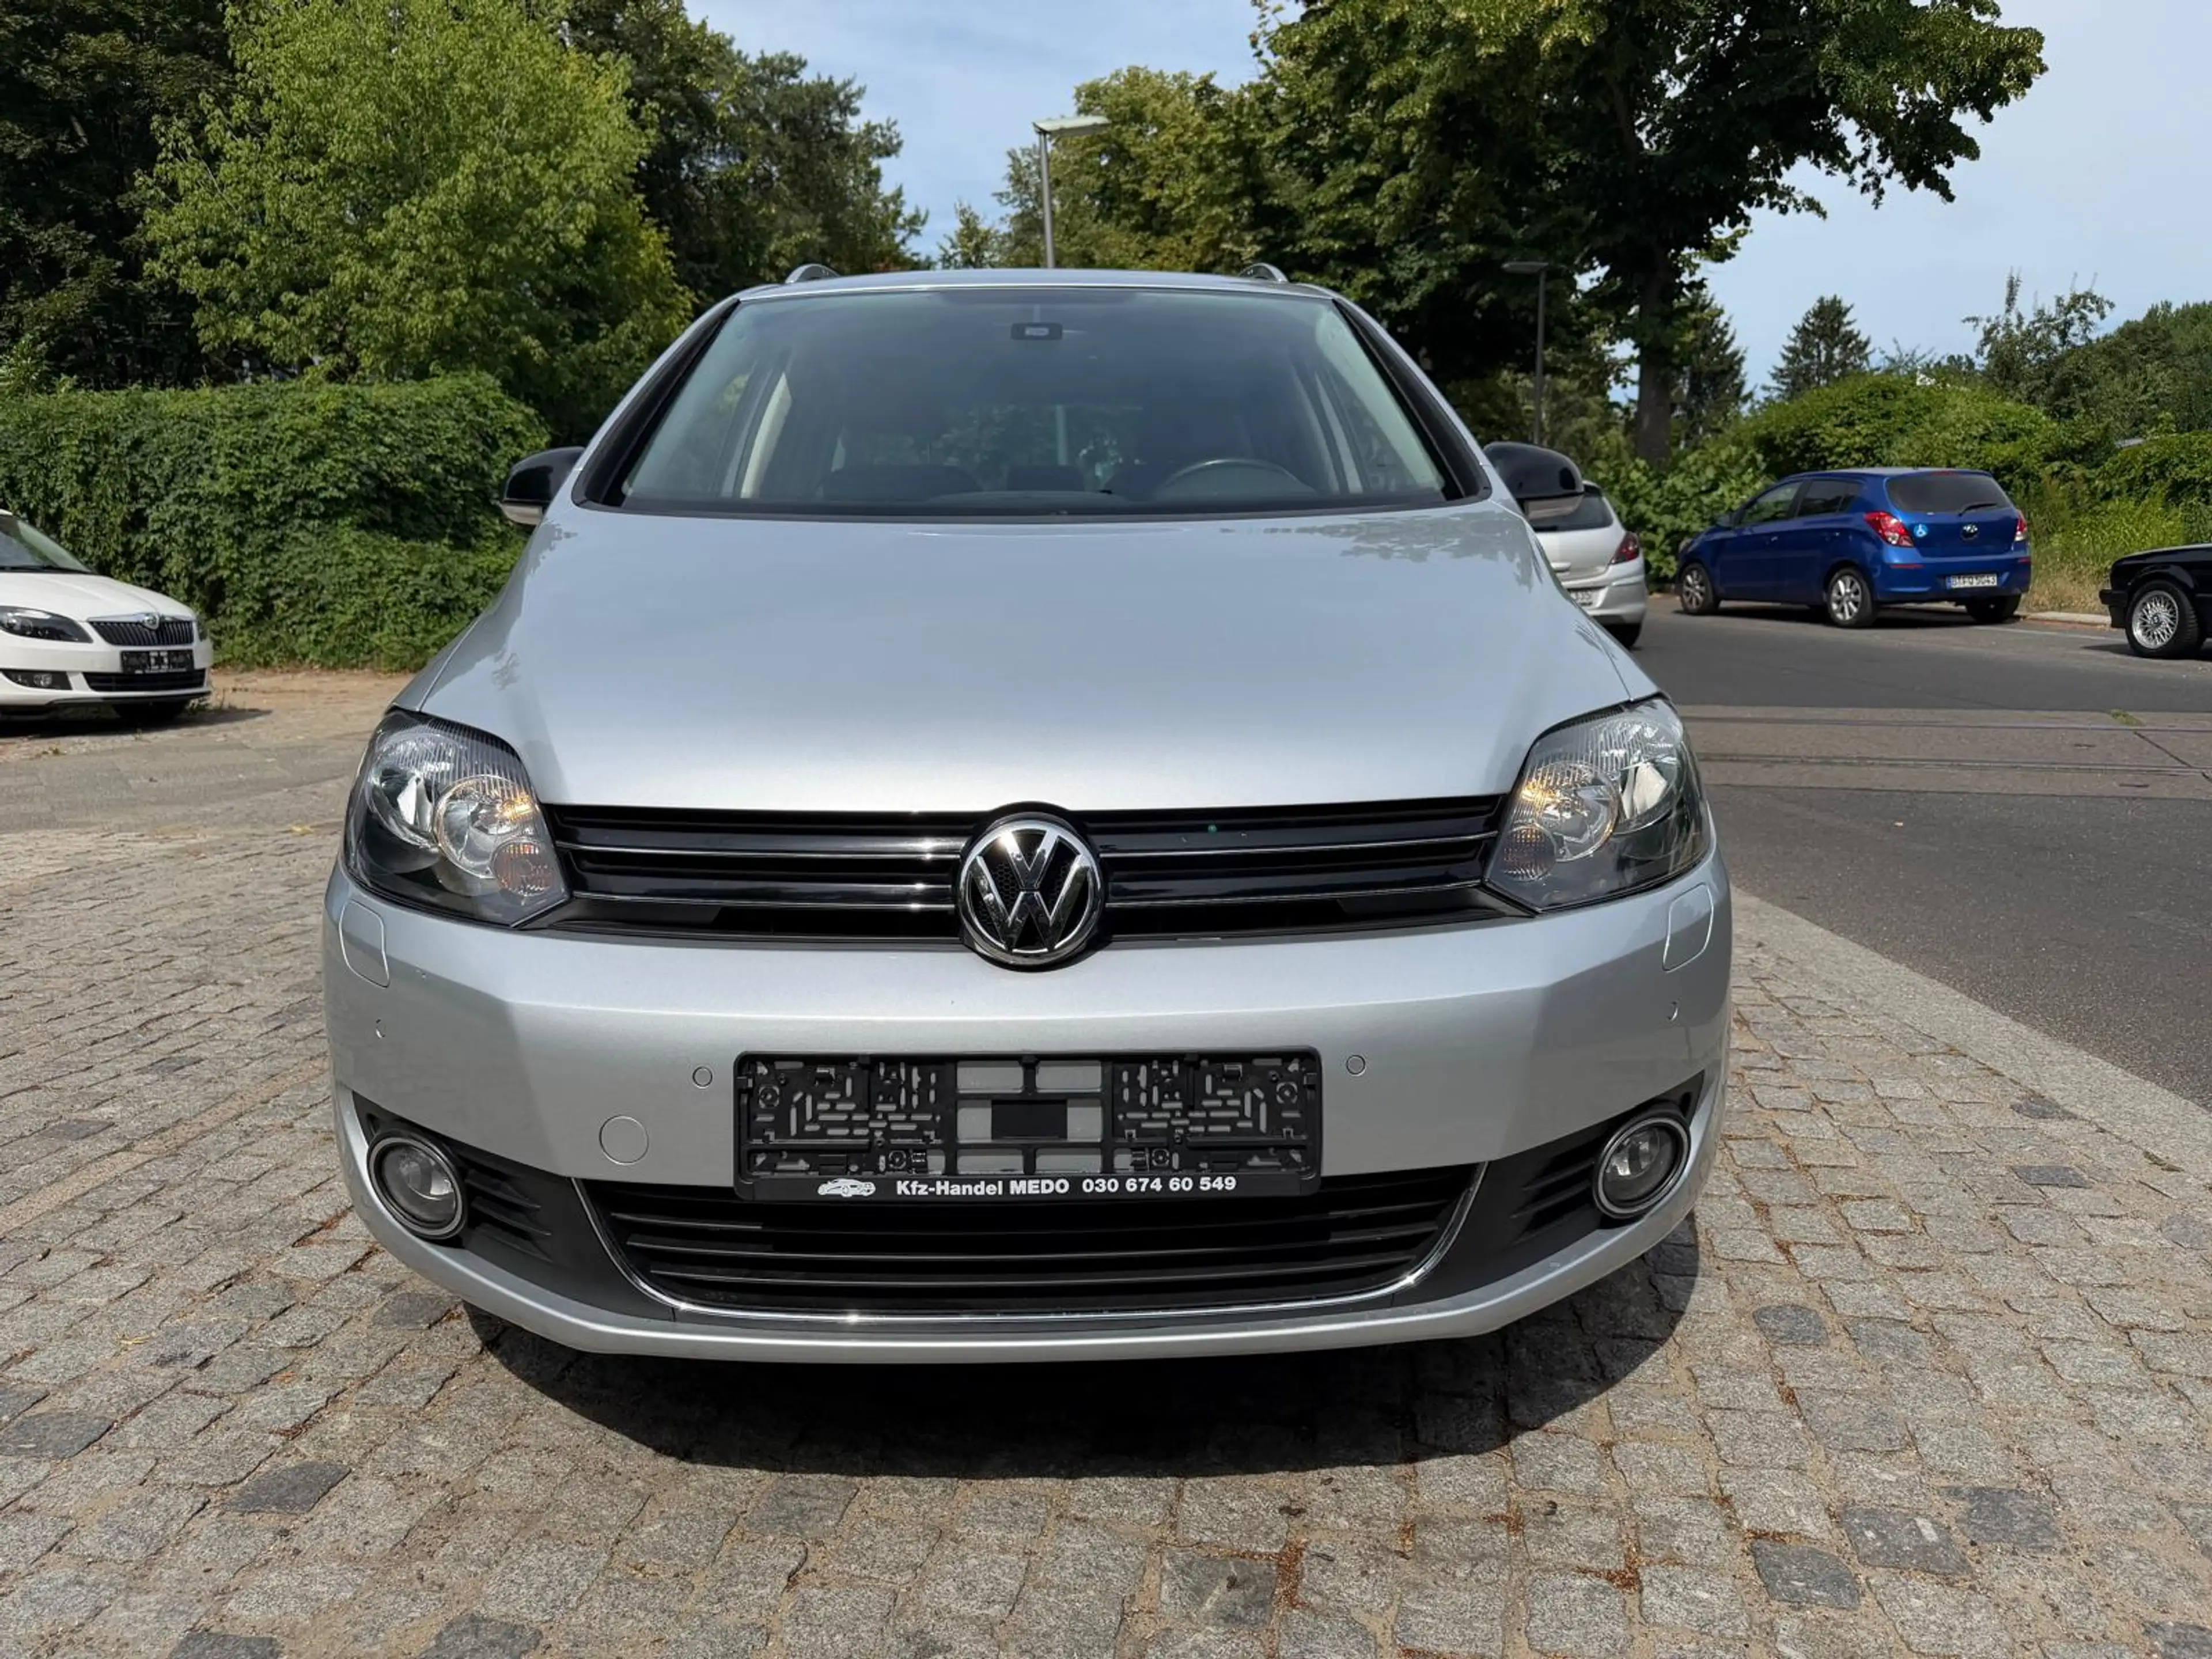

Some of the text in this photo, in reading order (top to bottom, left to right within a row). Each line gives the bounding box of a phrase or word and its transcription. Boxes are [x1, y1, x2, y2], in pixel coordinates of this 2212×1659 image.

[896, 1176, 1237, 1195] Kfz-Handel MEDO 030 674 60 549
